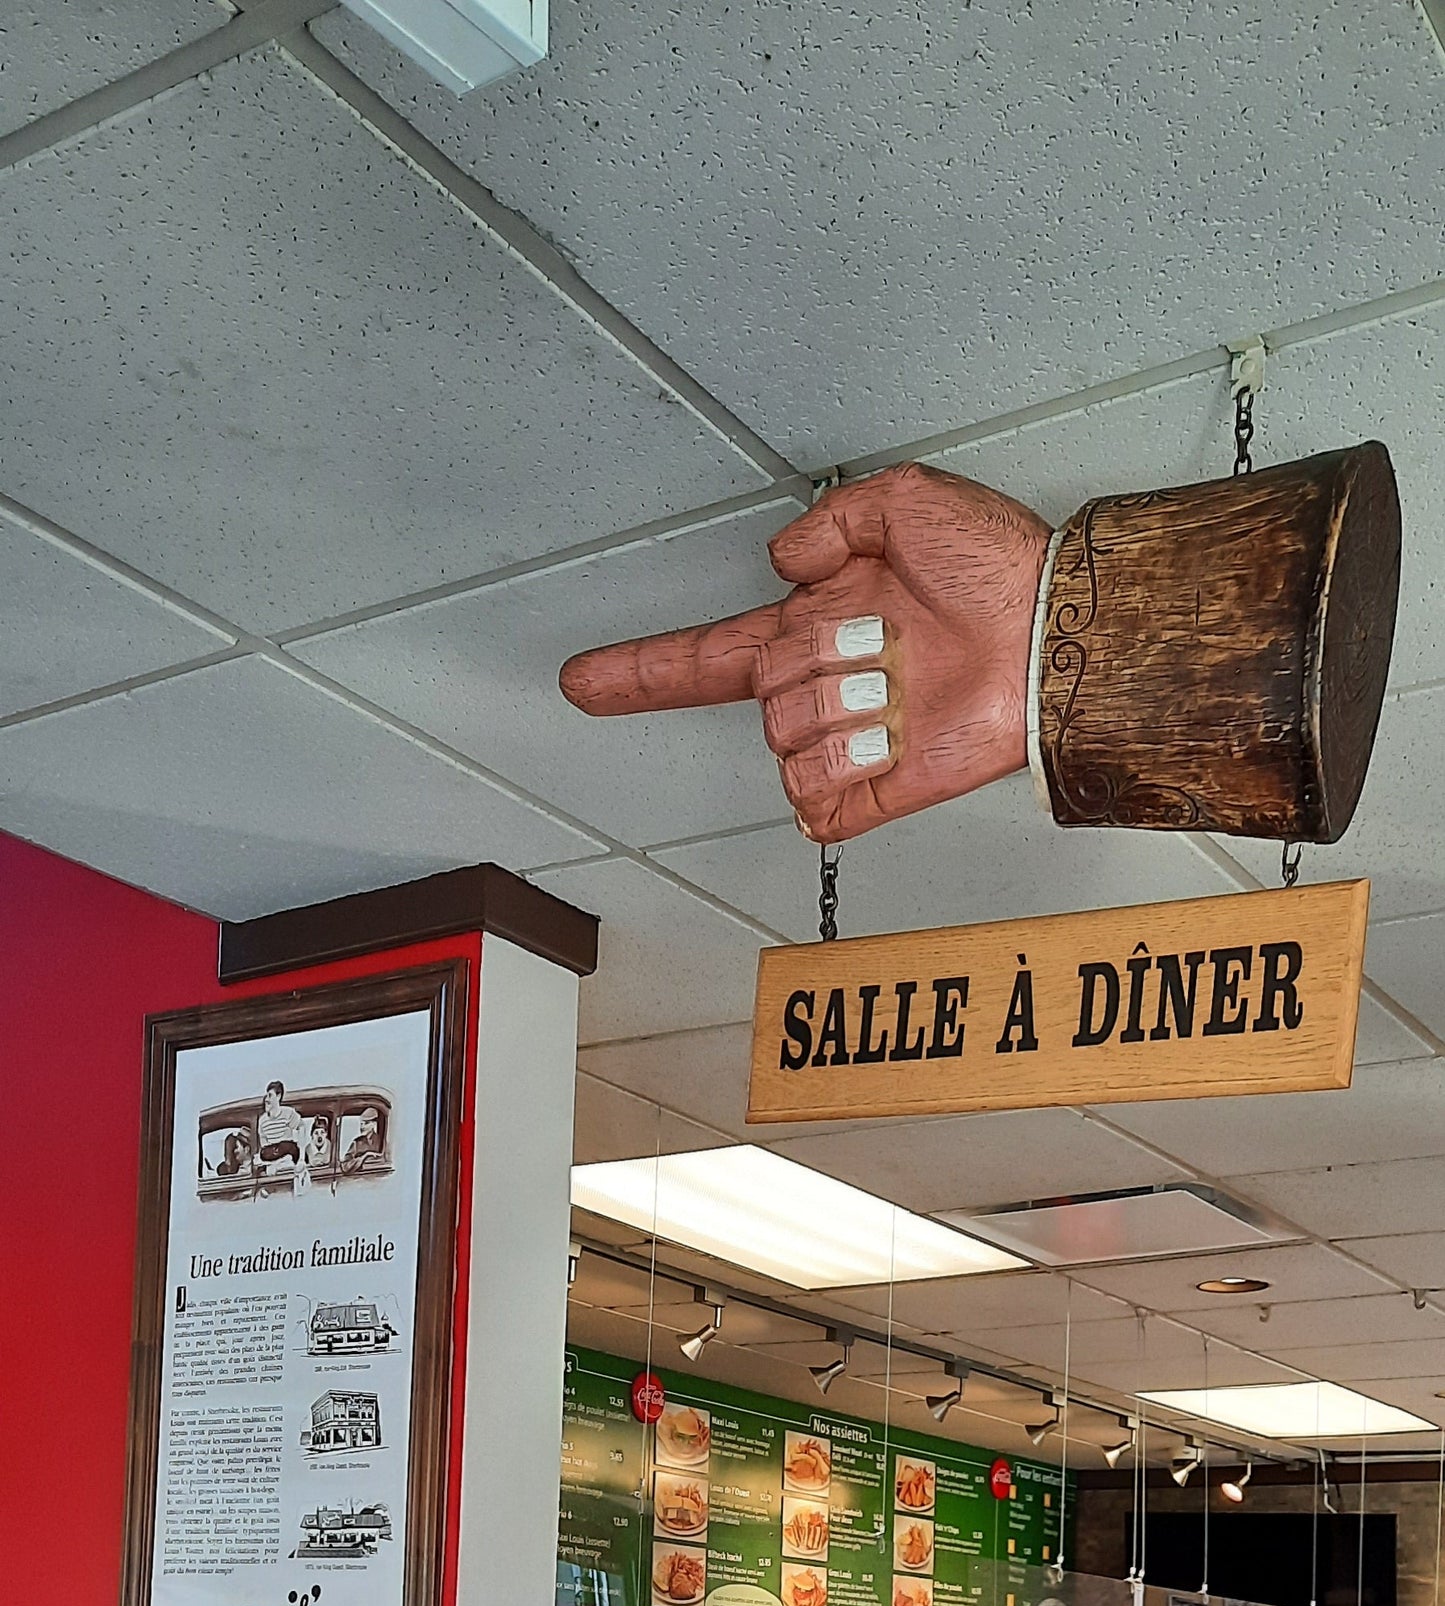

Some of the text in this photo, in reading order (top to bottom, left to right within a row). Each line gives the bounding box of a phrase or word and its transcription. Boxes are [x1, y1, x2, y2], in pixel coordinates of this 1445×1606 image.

[779, 941, 1303, 1070] SALLE À DÎNER
[190, 1233, 395, 1279] Une tradition familiale
[813, 1418, 868, 1444] Nos assiettes
[1016, 1465, 1033, 1480] Pour
[1033, 1469, 1042, 1482] les
